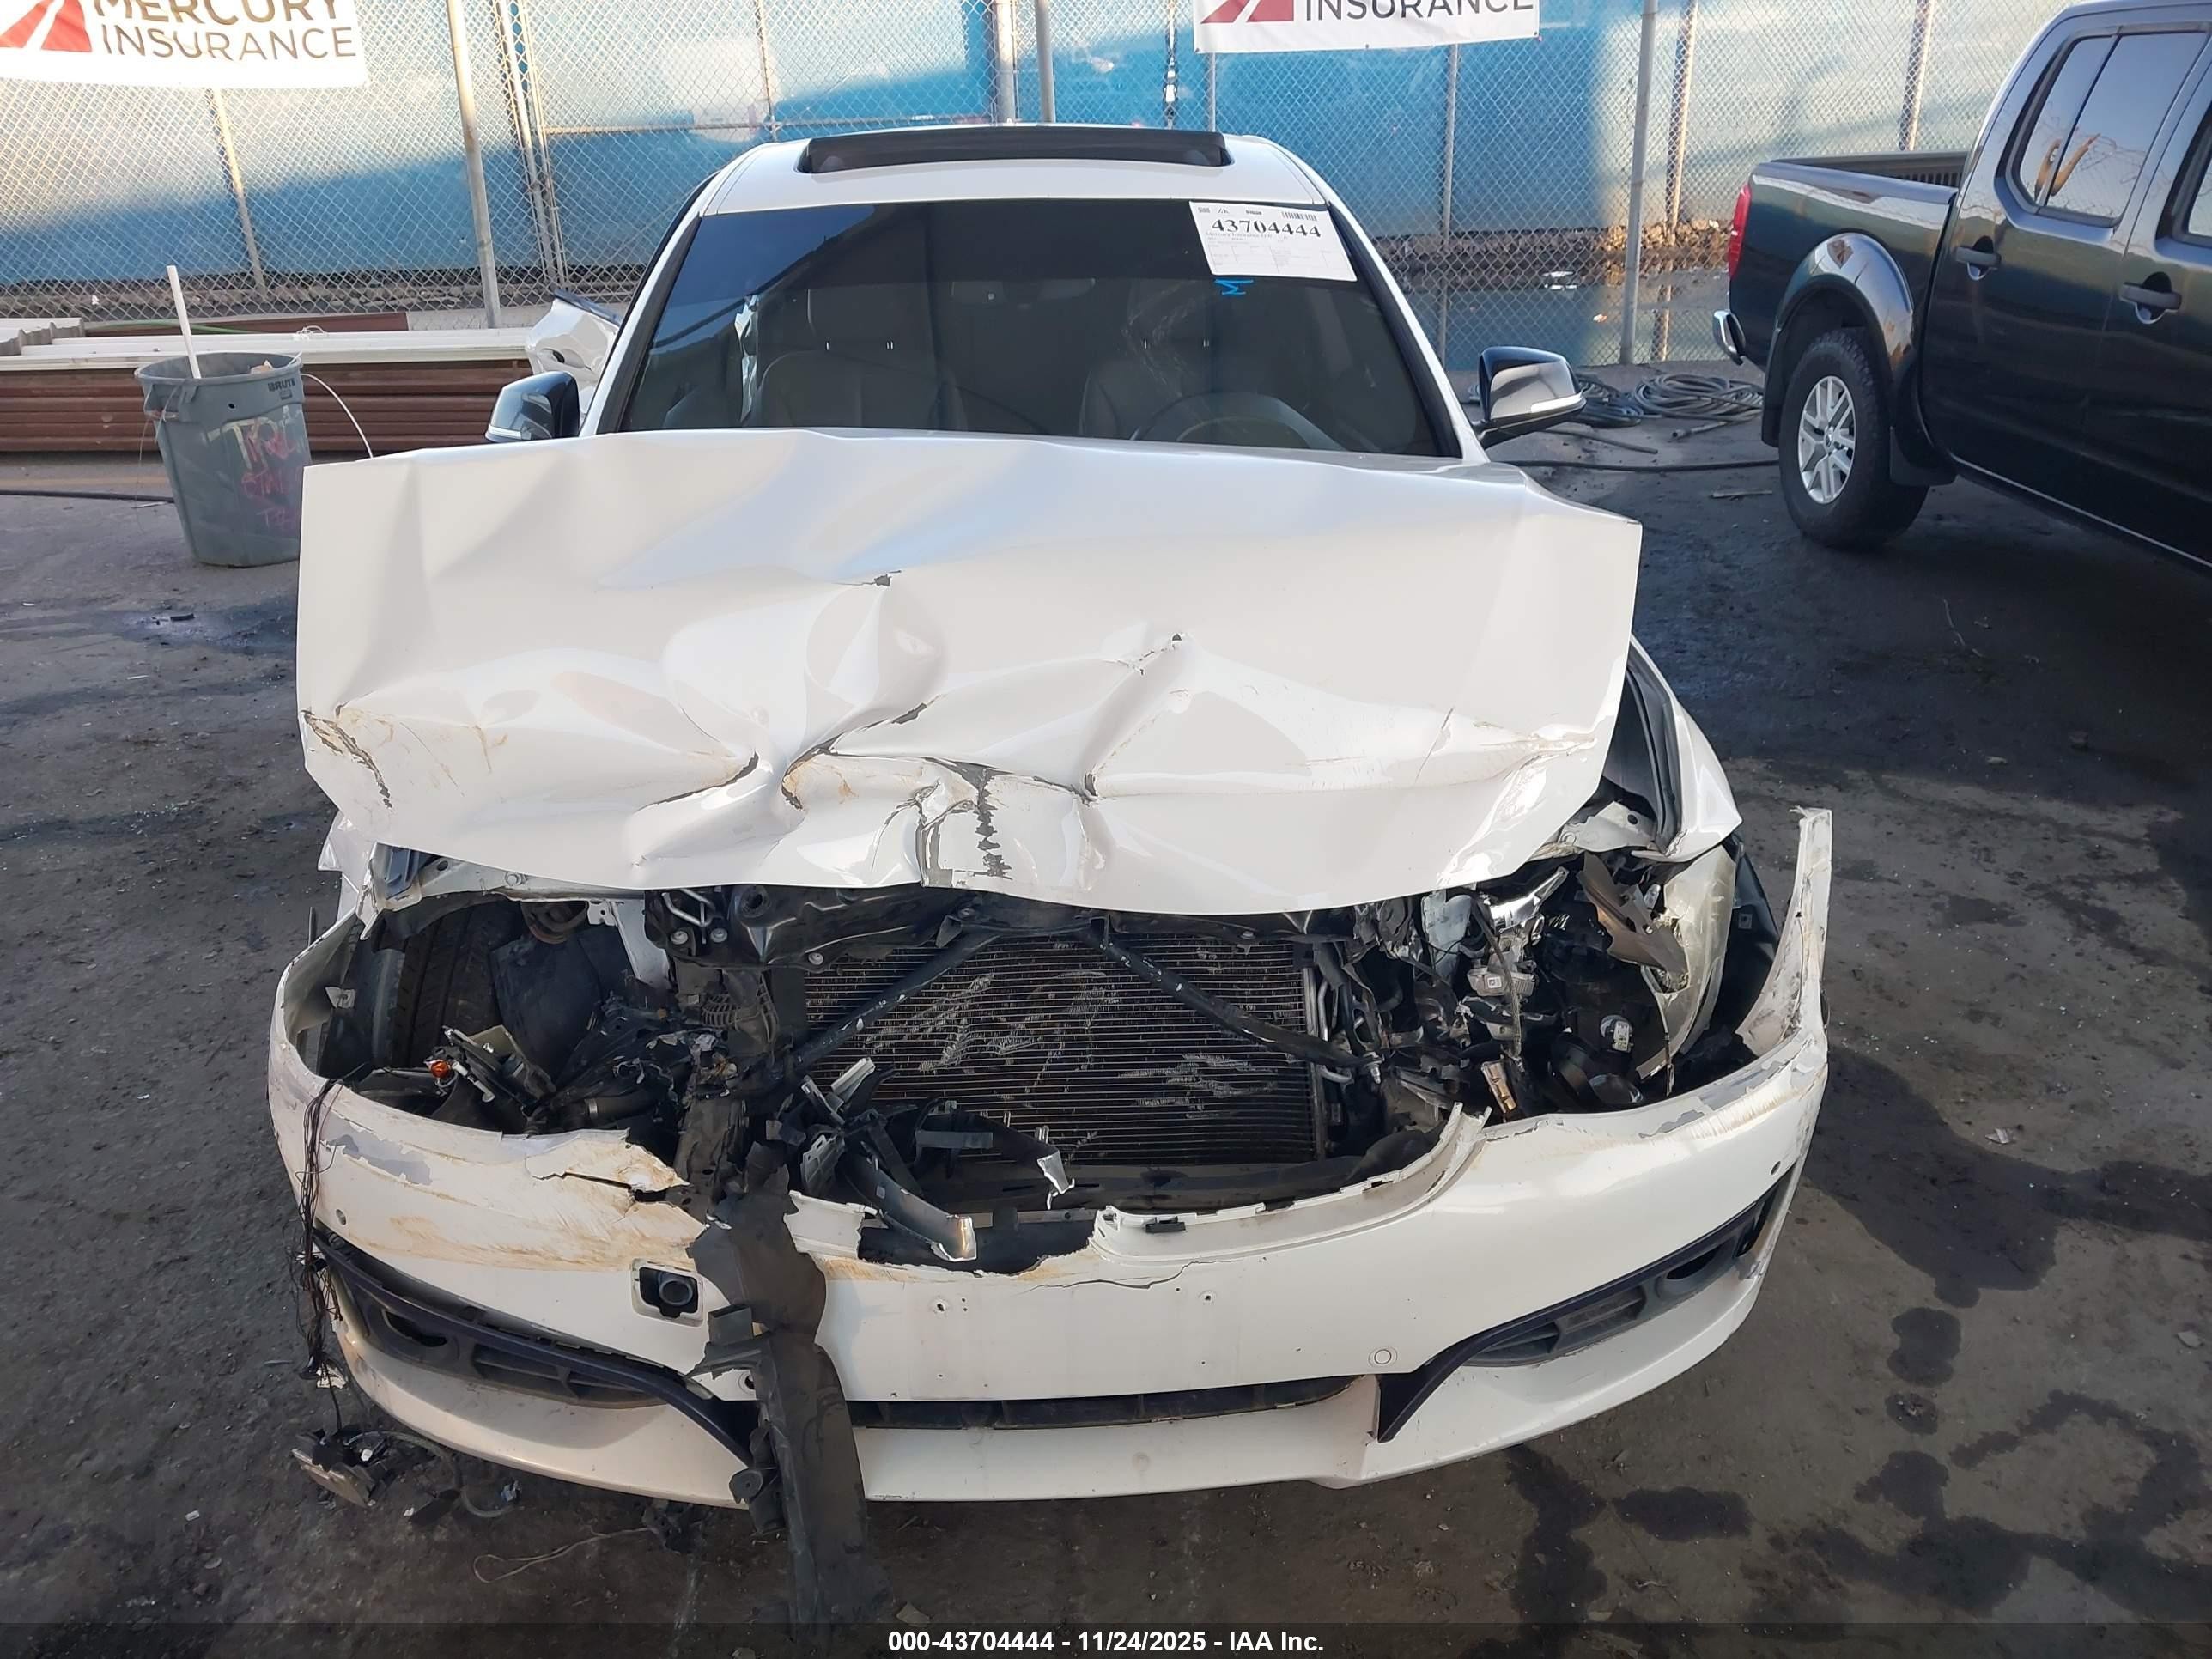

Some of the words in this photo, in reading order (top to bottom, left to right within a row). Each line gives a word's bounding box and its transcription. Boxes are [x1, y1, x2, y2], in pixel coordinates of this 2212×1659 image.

[94, 0, 336, 25] MERCURY
[101, 24, 356, 61] INSURANCE
[1212, 219, 1322, 237] 43704444
